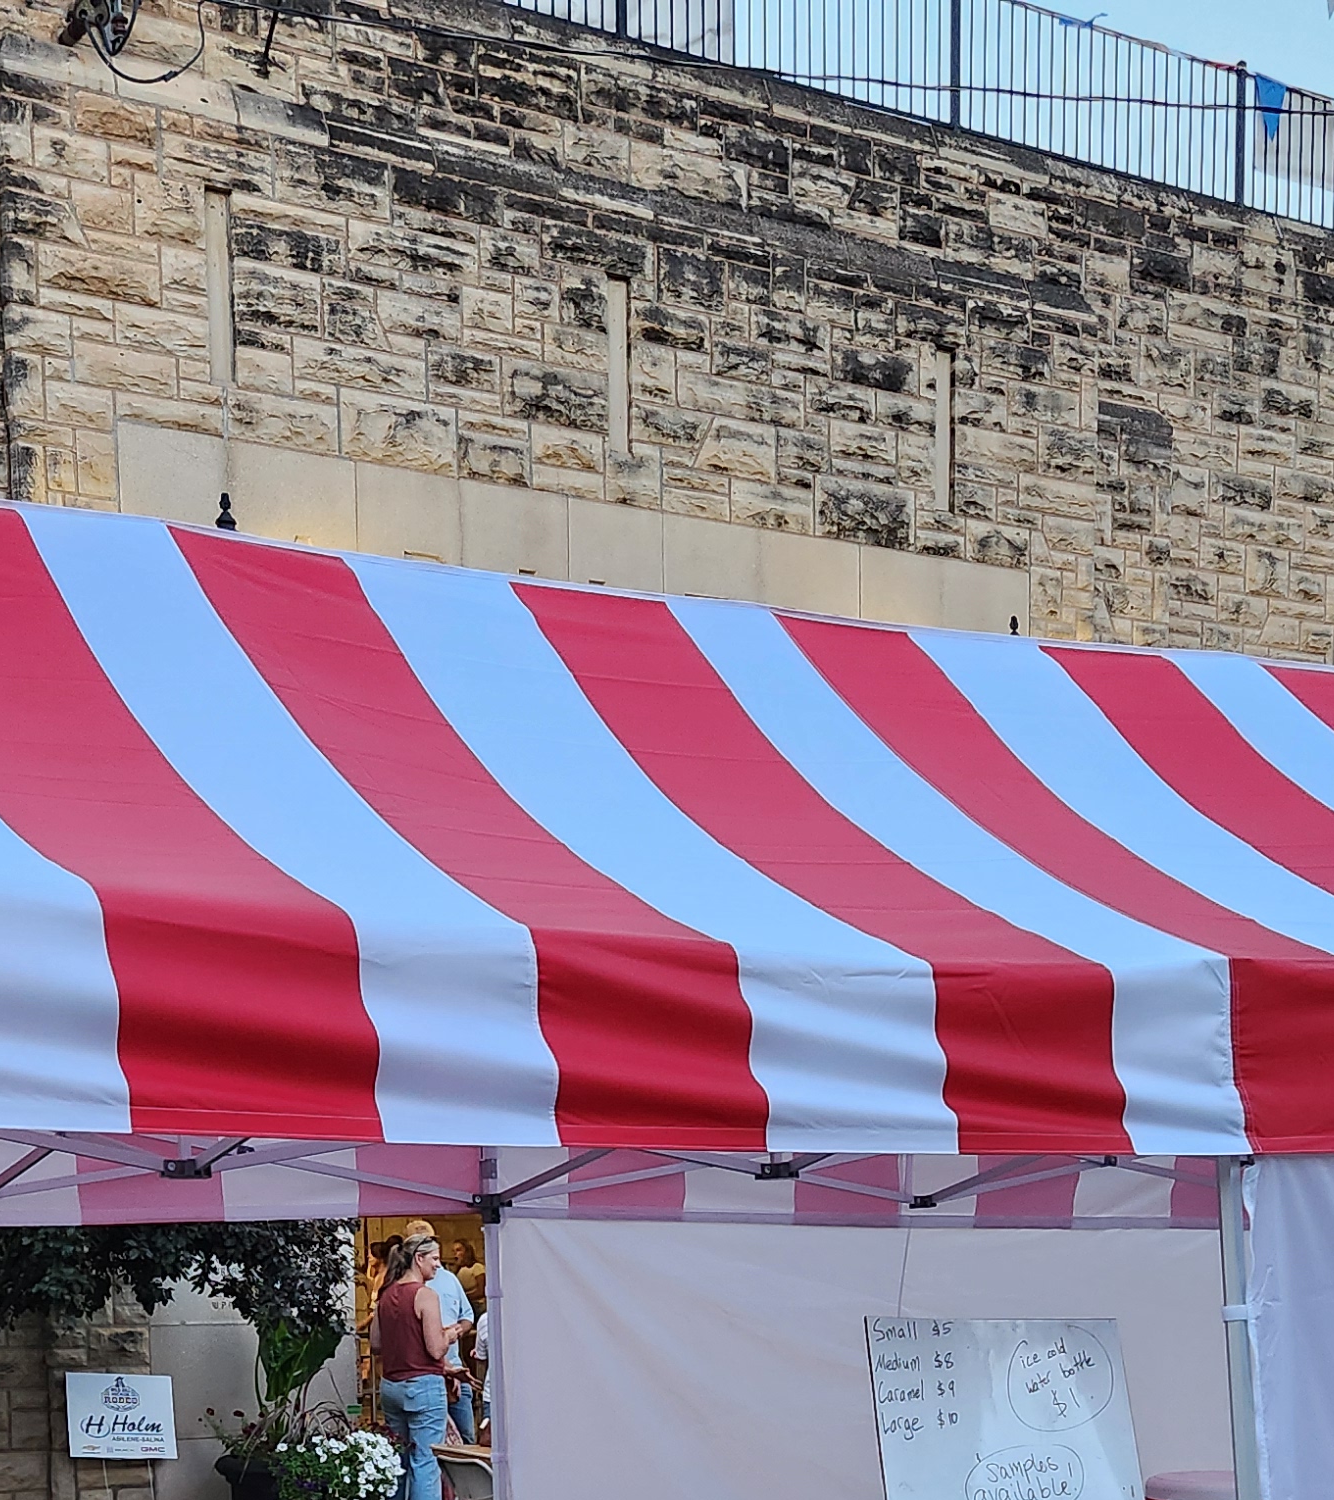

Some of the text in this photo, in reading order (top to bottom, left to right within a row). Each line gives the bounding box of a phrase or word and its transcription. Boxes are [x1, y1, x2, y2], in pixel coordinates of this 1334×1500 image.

[873, 1318, 954, 1342] Small $5
[875, 1351, 954, 1372] Medium $8
[1020, 1336, 1067, 1368] ice cold
[1059, 1350, 1095, 1378] bottle
[104, 1396, 138, 1404] RODEO
[878, 1379, 955, 1404] Caramel $9
[111, 1414, 163, 1433] Holm
[881, 1409, 958, 1441] Large $10
